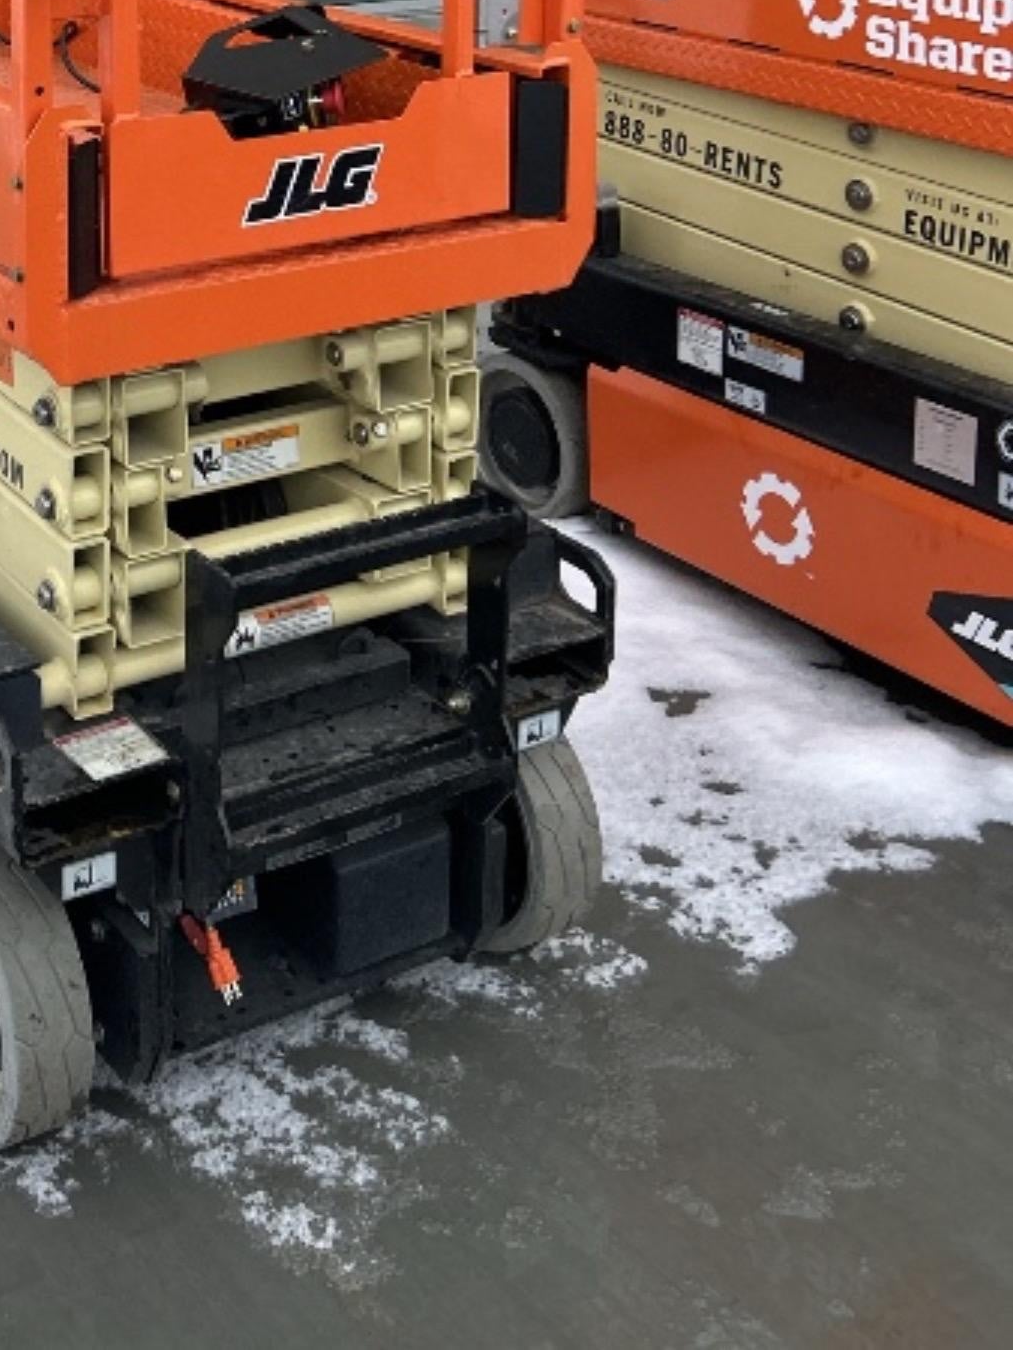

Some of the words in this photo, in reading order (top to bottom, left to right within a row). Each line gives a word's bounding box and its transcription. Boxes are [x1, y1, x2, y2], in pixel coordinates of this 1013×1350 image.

[242, 143, 384, 228] JLG
[604, 109, 784, 191] 888-80-RENTS
[904, 208, 1012, 268] EQUIPM
